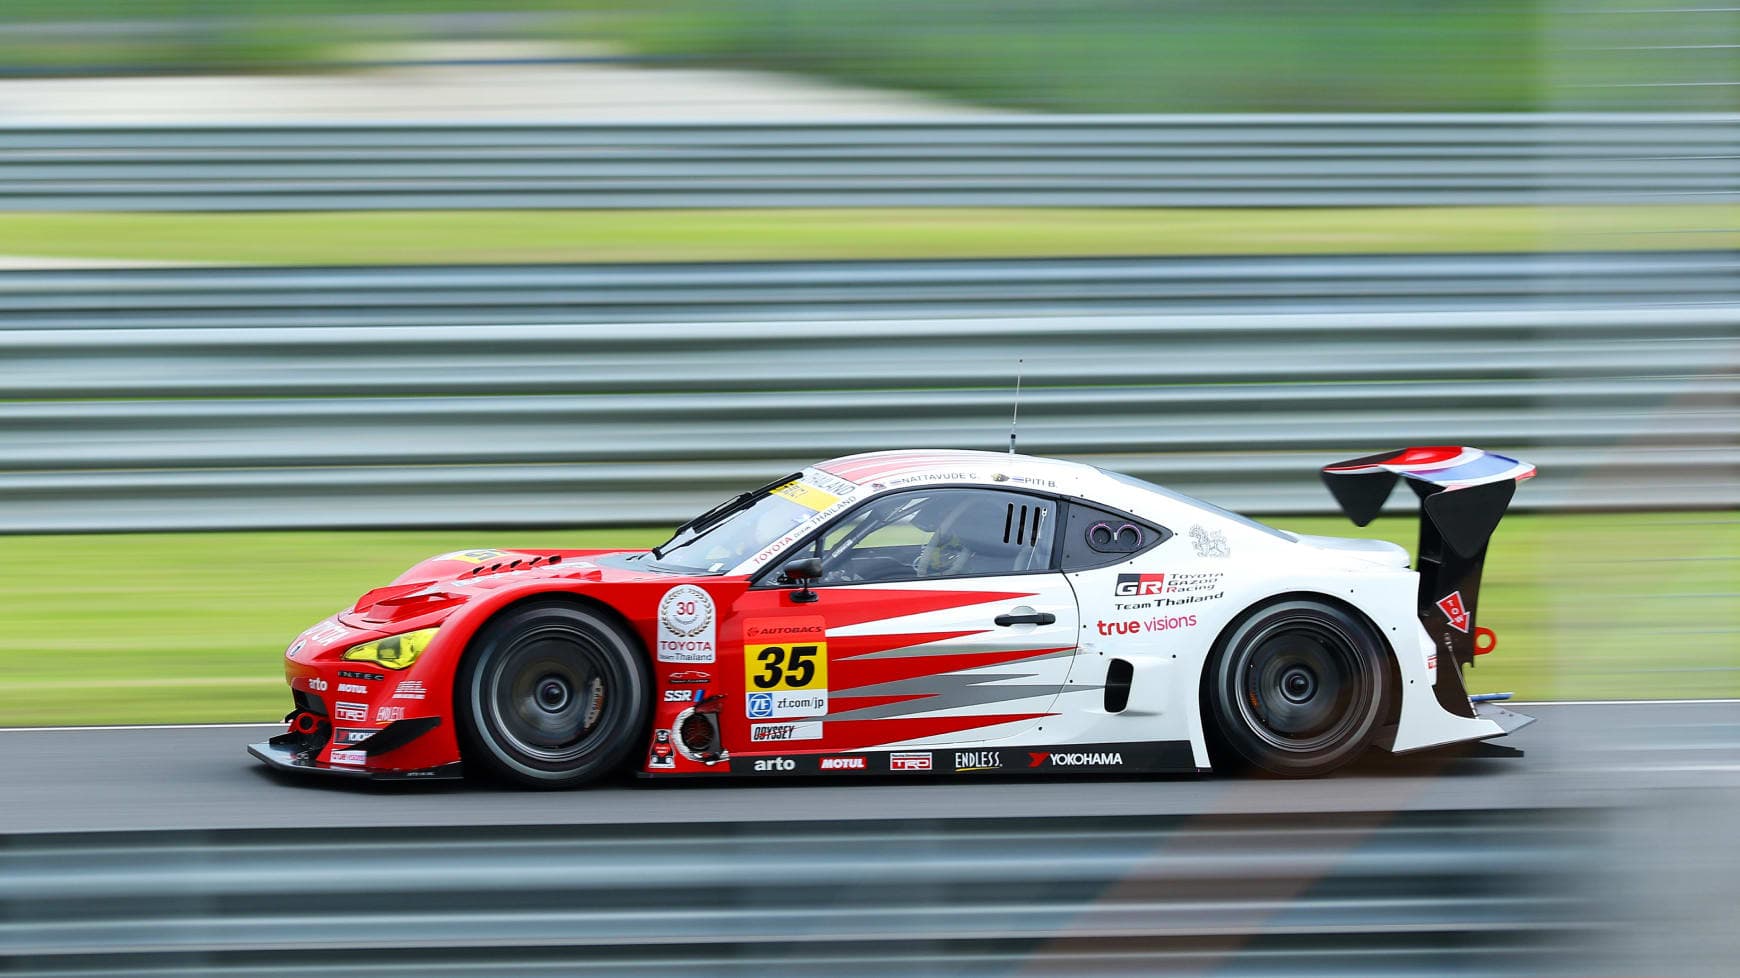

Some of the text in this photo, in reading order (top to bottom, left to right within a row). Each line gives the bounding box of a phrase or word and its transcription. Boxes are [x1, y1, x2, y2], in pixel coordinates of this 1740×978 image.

[901, 472, 966, 483] NATTAVUDE
[1024, 477, 1046, 487] PITI
[753, 537, 793, 565] TOYOTA
[812, 495, 857, 527] THAILAND
[1115, 580, 1162, 596] GR
[1166, 584, 1215, 594] Racing
[1115, 591, 1224, 611] Team Thailand
[676, 601, 695, 616] 30
[760, 626, 822, 635] AUTOBACS
[1097, 614, 1197, 636] true visions
[660, 641, 713, 651] TOYOTA
[753, 646, 818, 689] 35
[308, 677, 329, 692] arto
[663, 690, 692, 702] SSR
[777, 697, 824, 709] zf.com/jp
[751, 698, 770, 711] ZF
[754, 725, 795, 740] ODYSSEY
[754, 757, 796, 771] arto
[821, 758, 865, 769] MOTUL
[892, 758, 930, 769] TRD
[955, 752, 1000, 768] ENDLESS
[1050, 752, 1123, 766] YOKOHAMA
